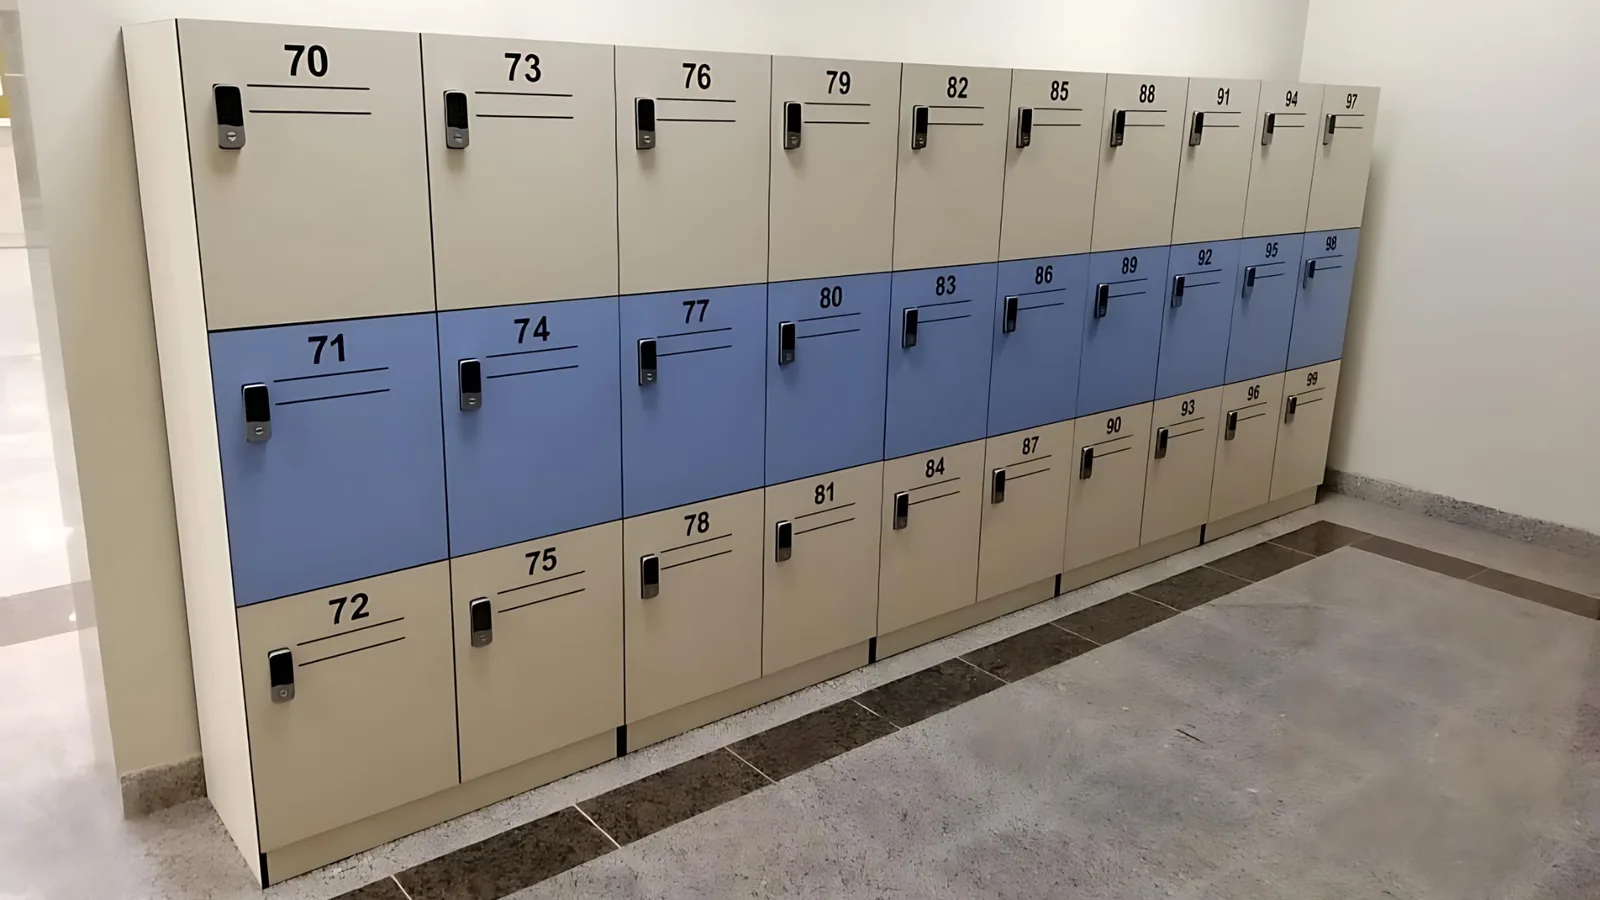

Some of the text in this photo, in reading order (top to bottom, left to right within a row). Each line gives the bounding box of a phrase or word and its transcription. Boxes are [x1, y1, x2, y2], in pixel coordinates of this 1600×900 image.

[284, 44, 328, 78] 70
[504, 52, 542, 83] 73
[682, 62, 712, 90] 76
[826, 70, 851, 95] 79
[946, 76, 969, 99] 82
[1050, 80, 1070, 102] 85
[1139, 83, 1156, 104] 88
[1216, 87, 1230, 106] 91
[1285, 90, 1299, 107] 94
[1345, 93, 1358, 109] 97
[1265, 241, 1279, 259] 95
[1325, 235, 1337, 252] 98
[1121, 255, 1138, 275] 89
[1197, 248, 1213, 267] 92
[935, 274, 957, 297] 83
[1034, 264, 1054, 285] 86
[819, 285, 843, 309] 80
[682, 298, 710, 324] 77
[513, 315, 551, 344] 74
[307, 333, 346, 365] 71
[1306, 371, 1318, 387] 99
[1247, 384, 1261, 402] 96
[1180, 398, 1195, 417] 93
[1106, 416, 1122, 435] 90
[1022, 435, 1040, 456] 87
[925, 456, 946, 479] 84
[814, 481, 834, 505] 81
[684, 511, 710, 537] 78
[524, 546, 557, 576] 75
[328, 592, 370, 625] 72
